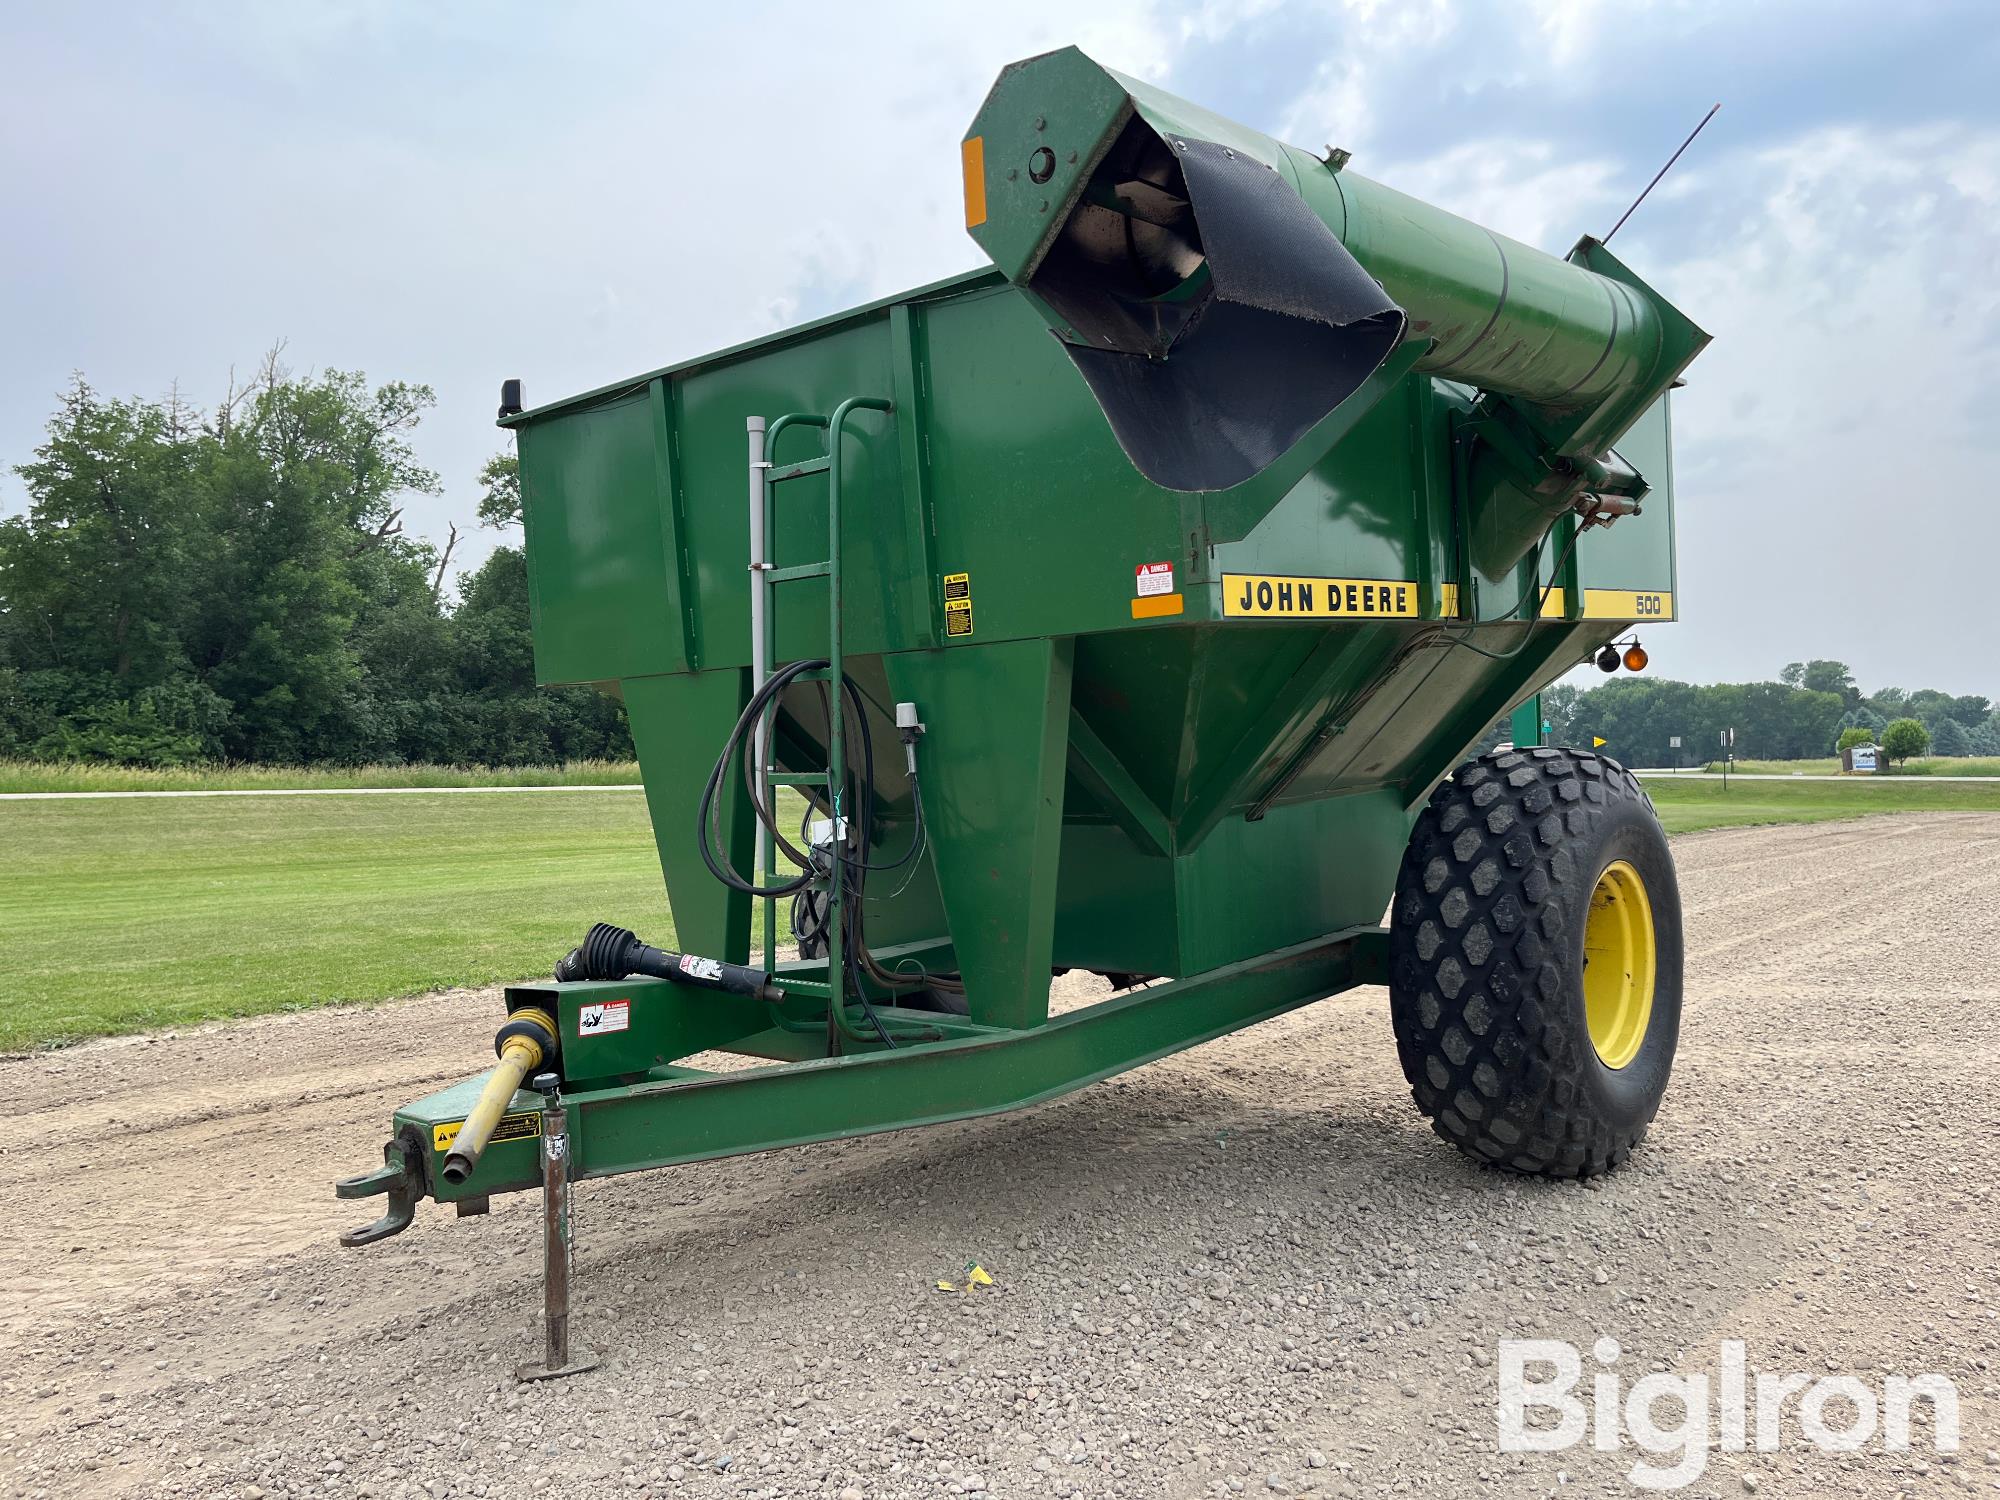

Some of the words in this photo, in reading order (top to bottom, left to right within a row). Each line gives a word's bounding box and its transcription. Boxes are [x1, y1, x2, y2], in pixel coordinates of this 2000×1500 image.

[1150, 563, 1169, 573] DANGER
[1240, 581, 1313, 611] JOHN
[1328, 584, 1407, 612] DEERE
[1636, 595, 1661, 615] 500
